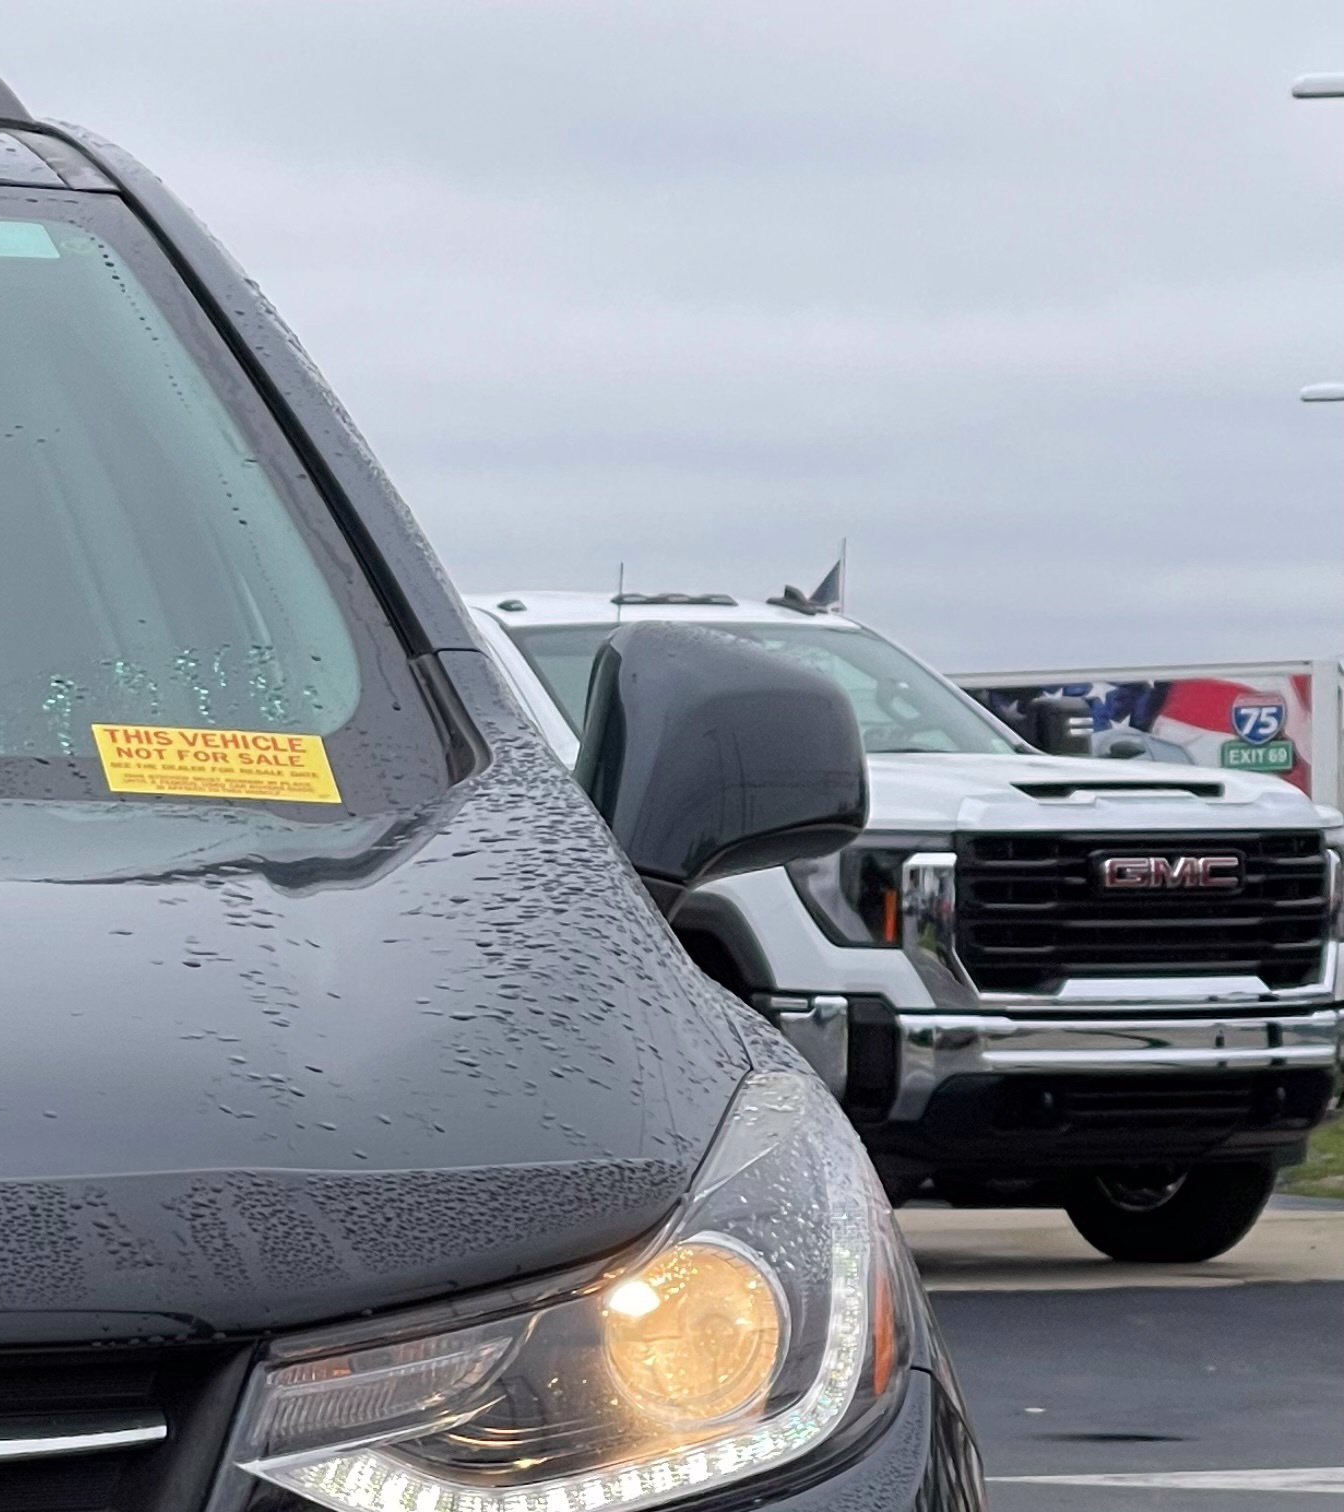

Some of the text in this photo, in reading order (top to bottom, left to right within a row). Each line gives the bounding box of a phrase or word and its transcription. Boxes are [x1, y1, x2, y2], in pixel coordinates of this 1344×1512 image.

[1240, 706, 1278, 735] 75
[103, 728, 307, 753] THIS VEHICLE
[116, 746, 305, 768] NOT FOR SALE
[1229, 747, 1288, 764] EXIT 69
[1104, 857, 1240, 888] GMC
